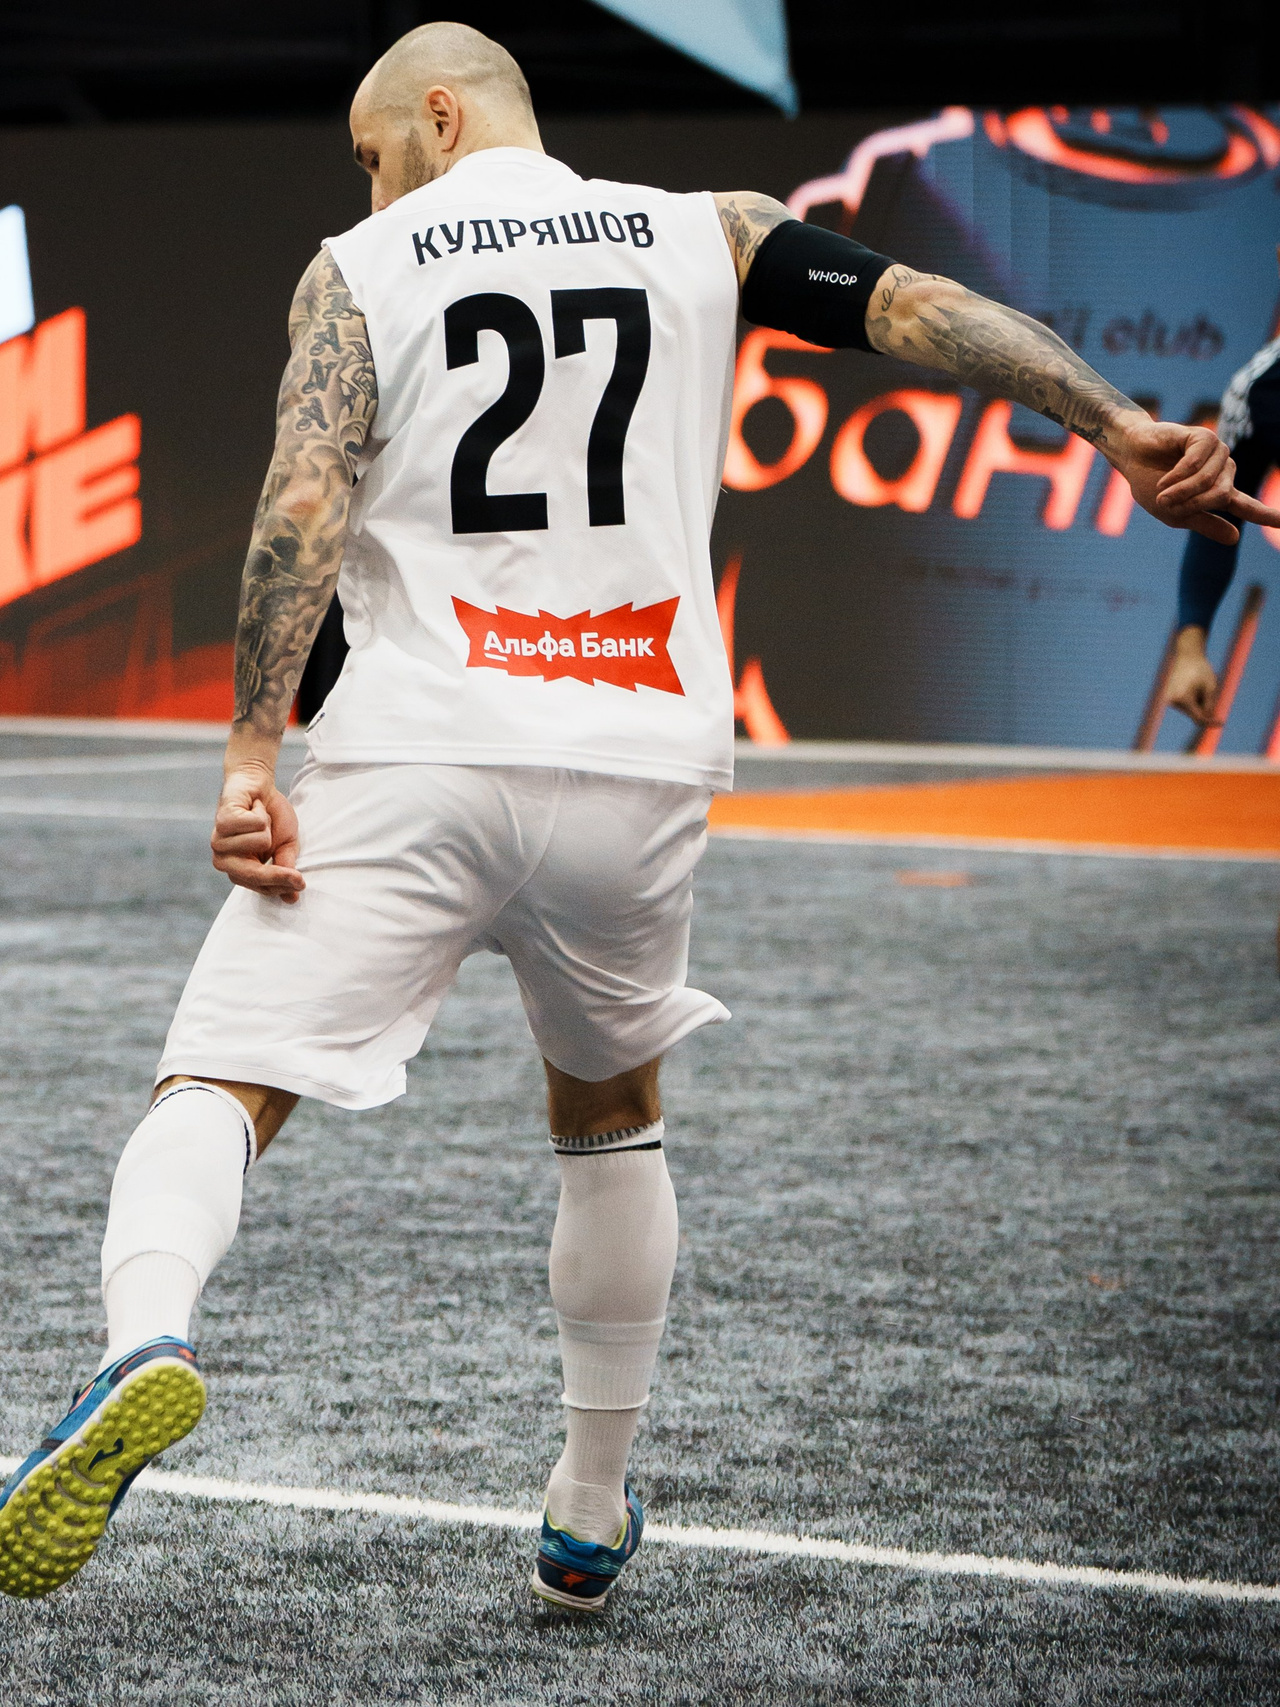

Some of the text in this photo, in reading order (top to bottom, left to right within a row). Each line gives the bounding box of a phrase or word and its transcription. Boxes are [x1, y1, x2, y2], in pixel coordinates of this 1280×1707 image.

[411, 210, 655, 267] КУДРЯШОВ
[808, 268, 858, 286] WHOOP
[443, 286, 652, 535] 27
[483, 630, 656, 662] Альфа Банк
